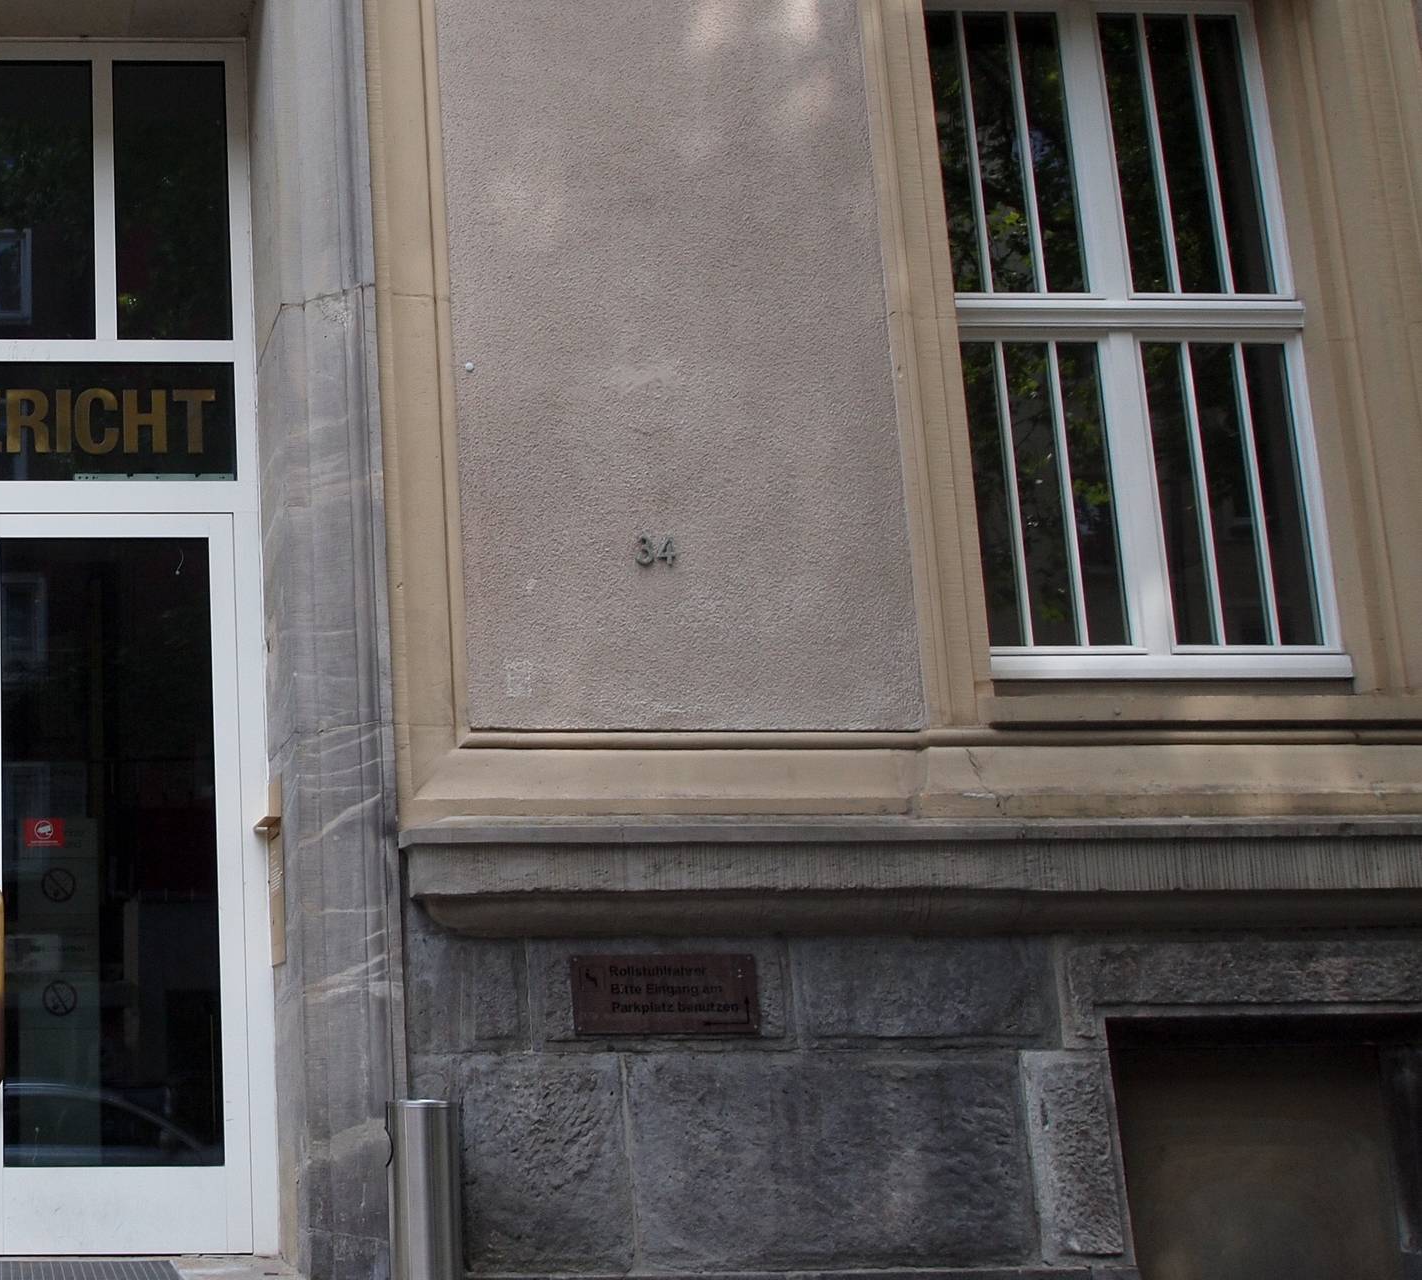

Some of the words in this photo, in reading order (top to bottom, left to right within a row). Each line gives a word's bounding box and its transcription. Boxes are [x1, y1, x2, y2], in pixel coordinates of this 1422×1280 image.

[635, 528, 676, 567] 34
[610, 983, 642, 995] Bitte
[646, 983, 700, 997] Eingang
[702, 986, 723, 995] am
[611, 1001, 674, 1014] Parkplatz
[677, 1001, 739, 1013] benutzen
